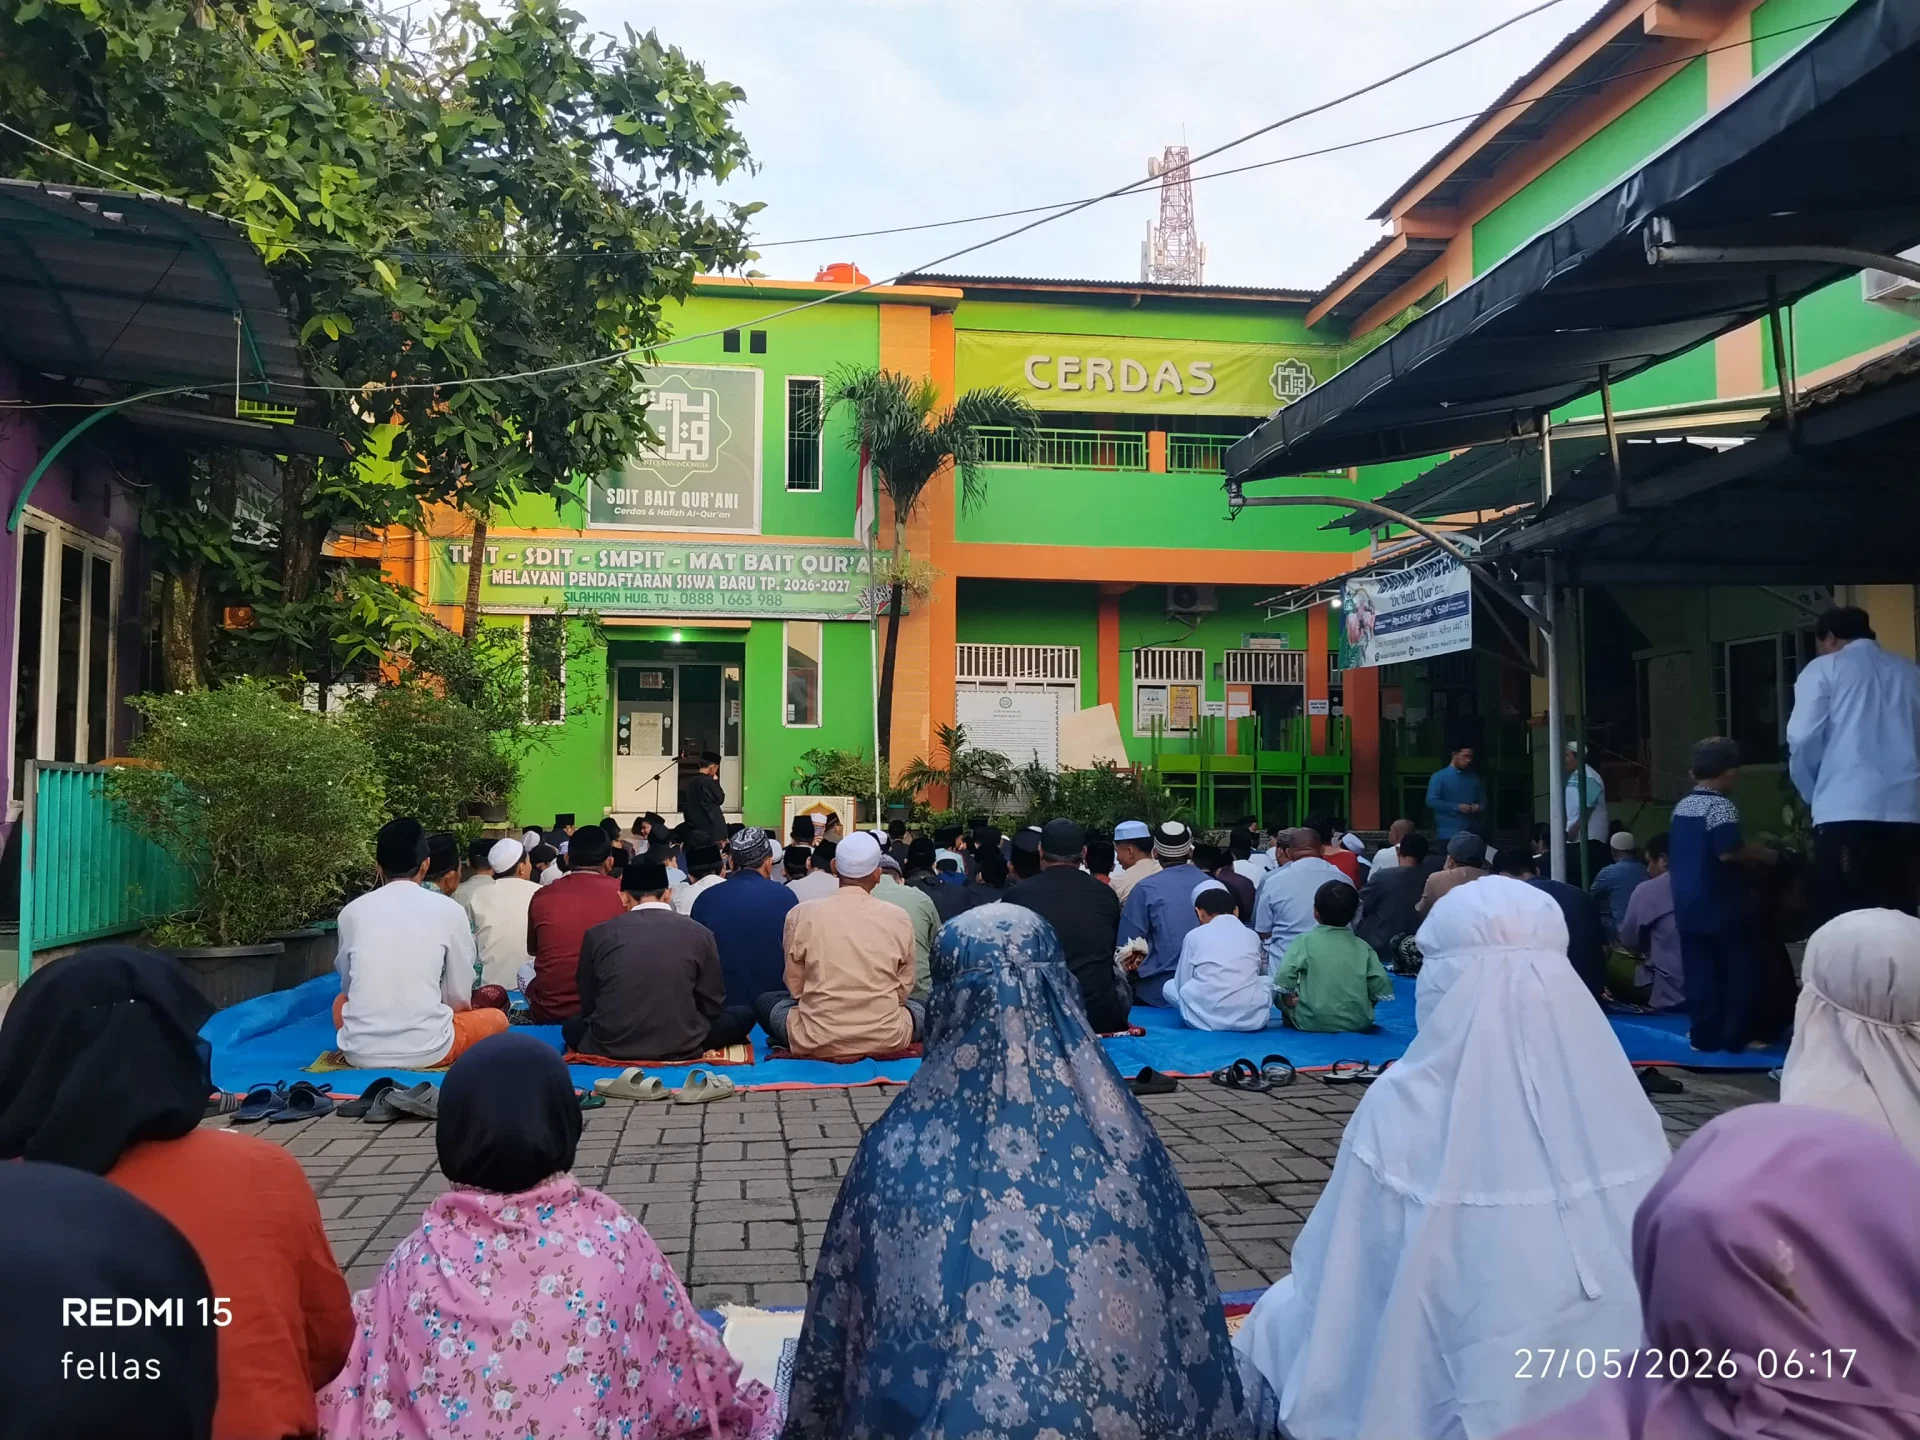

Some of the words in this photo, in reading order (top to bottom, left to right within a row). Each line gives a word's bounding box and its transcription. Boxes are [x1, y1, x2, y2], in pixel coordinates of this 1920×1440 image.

[1024, 355, 1216, 395] CERDAS
[606, 488, 639, 505] SDIT
[644, 489, 676, 506] BAIT
[681, 491, 739, 509] QUR'ANI
[614, 507, 647, 516] Cerdas
[648, 508, 655, 516] &
[656, 508, 685, 517] Hafizh
[686, 510, 731, 519] Al-Qur'an
[524, 546, 575, 567] SDIT
[599, 549, 665, 569] SMPIT
[689, 552, 737, 571] MAT
[744, 553, 796, 572] BAIT
[492, 569, 565, 586] MELAYANI
[569, 571, 673, 589] PENDAFTARAN
[676, 573, 715, 590] SISWA
[719, 575, 756, 591] BARU
[760, 576, 780, 591] TP.
[784, 578, 851, 593] 2026-2027
[563, 591, 620, 604] SILAHKAN
[625, 592, 652, 605] HUB.
[655, 593, 669, 605] TU
[680, 592, 714, 606] 0888
[720, 593, 752, 606] 1663
[757, 593, 783, 606] 988
[863, 583, 893, 598] KOTA
[857, 593, 893, 608] TEBATA
